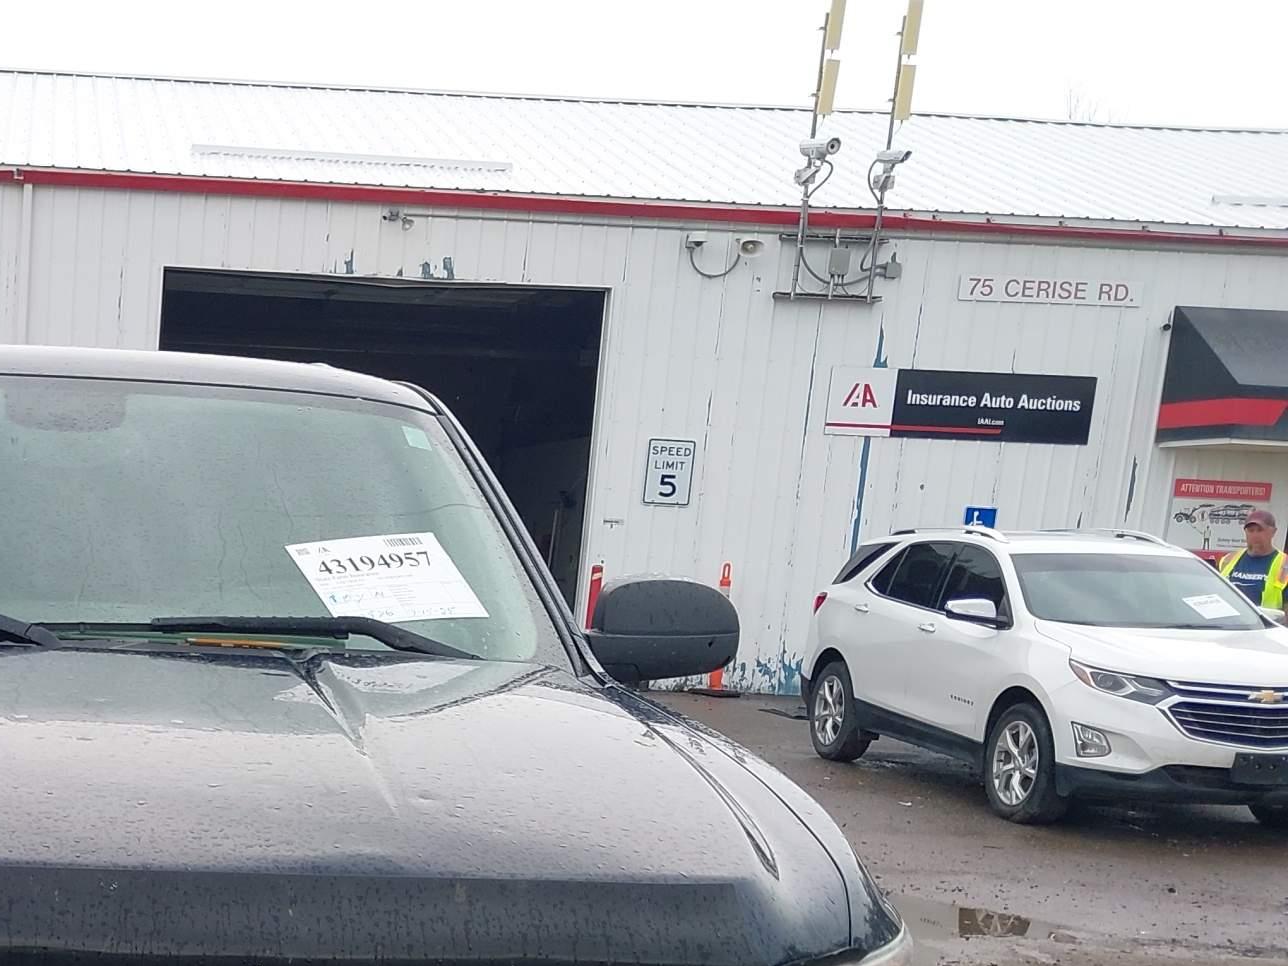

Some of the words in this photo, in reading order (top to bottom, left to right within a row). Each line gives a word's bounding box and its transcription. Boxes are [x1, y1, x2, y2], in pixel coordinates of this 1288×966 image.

[968, 278, 994, 297] 75
[1004, 279, 1088, 300] CERISE
[1098, 283, 1134, 302] RD.
[907, 390, 976, 408] Insurance
[981, 392, 1014, 410] Auto
[1017, 394, 1081, 412] Auctions
[652, 446, 692, 457] SPEED
[654, 460, 686, 471] LIMIT
[658, 474, 676, 497] 5
[1180, 483, 1214, 494] ATTENTION
[318, 551, 431, 575] 43194957
